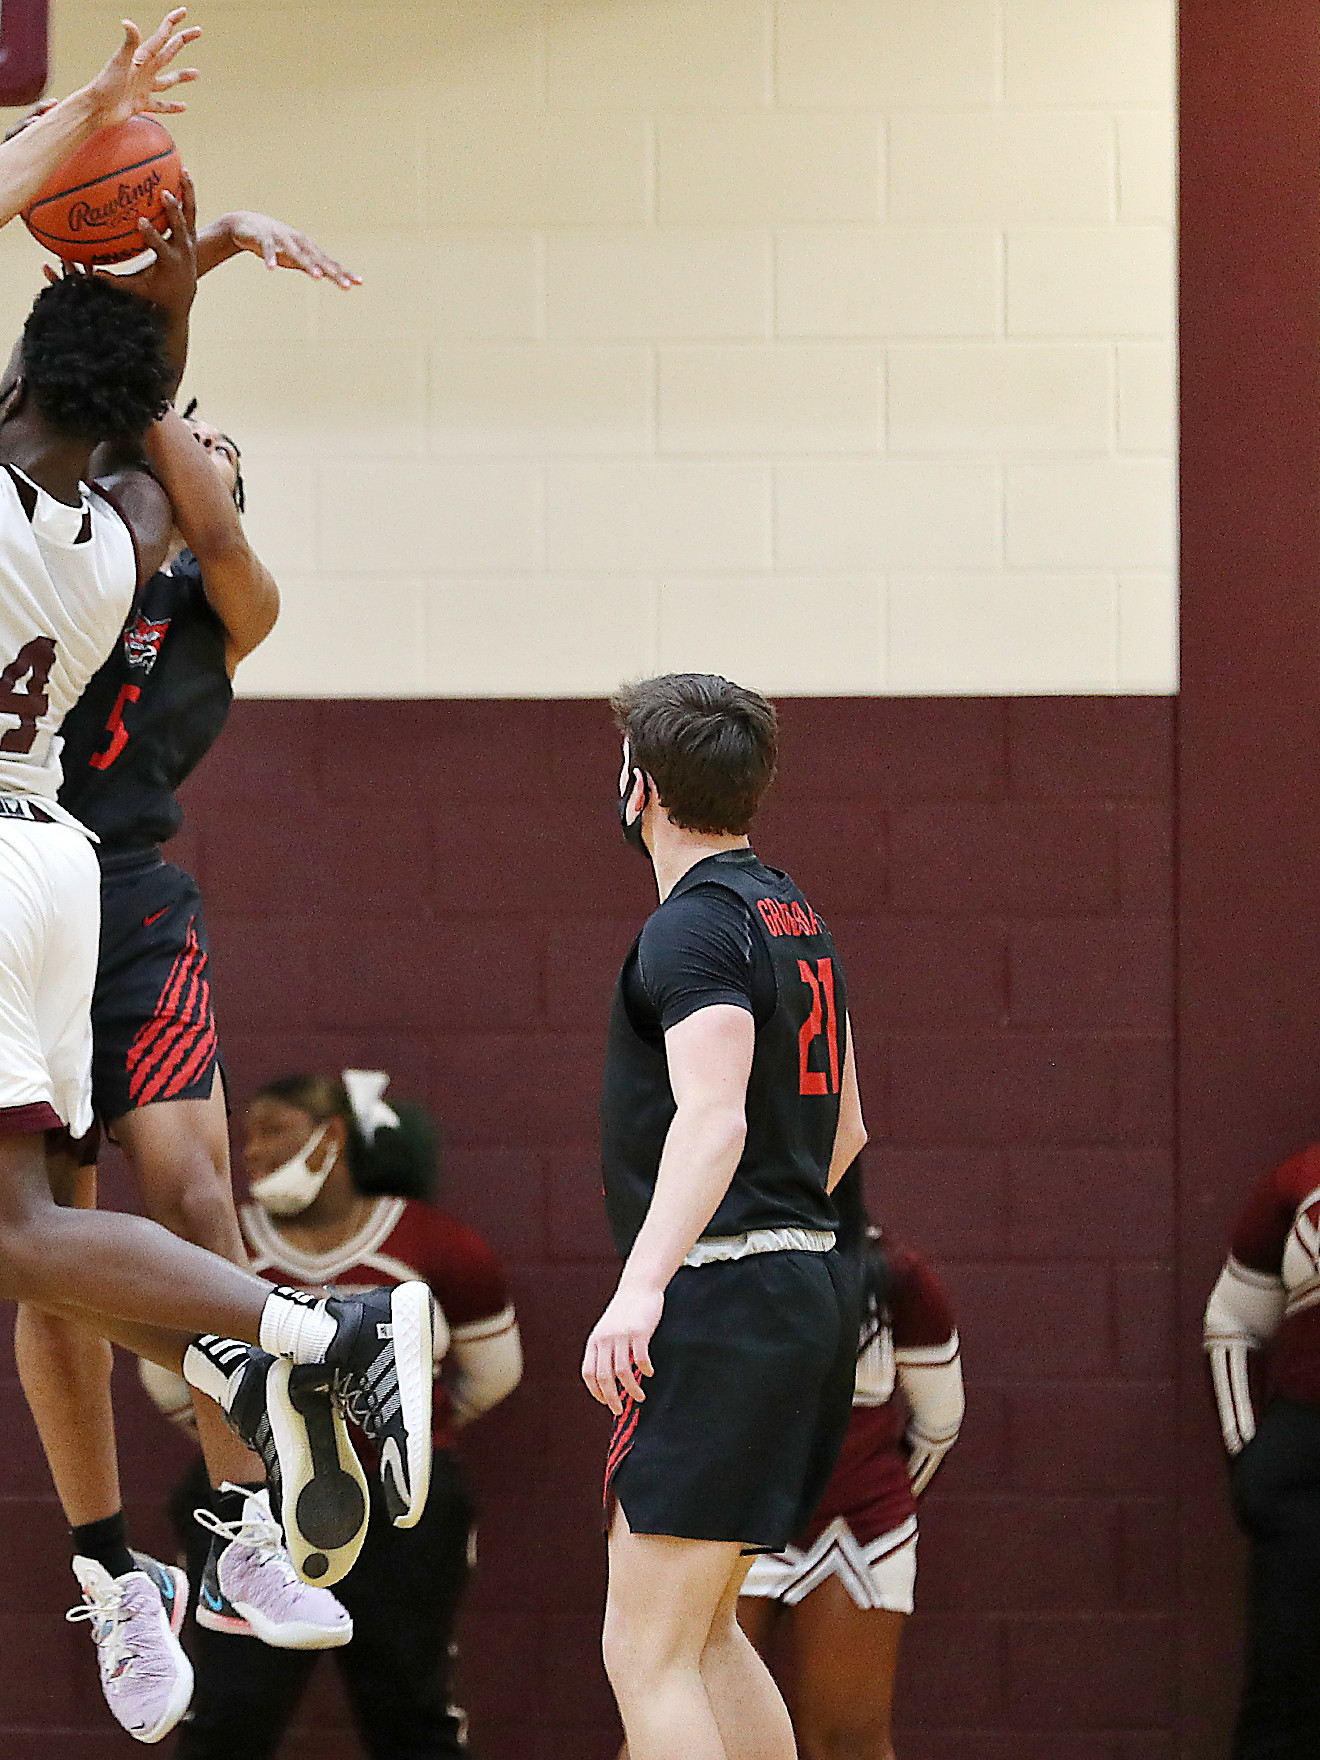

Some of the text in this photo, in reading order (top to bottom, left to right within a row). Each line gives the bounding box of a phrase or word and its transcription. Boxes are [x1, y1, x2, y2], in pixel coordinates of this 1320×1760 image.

[69, 171, 160, 231] Rawlings
[89, 684, 140, 770] 5
[797, 958, 839, 1095] 21
